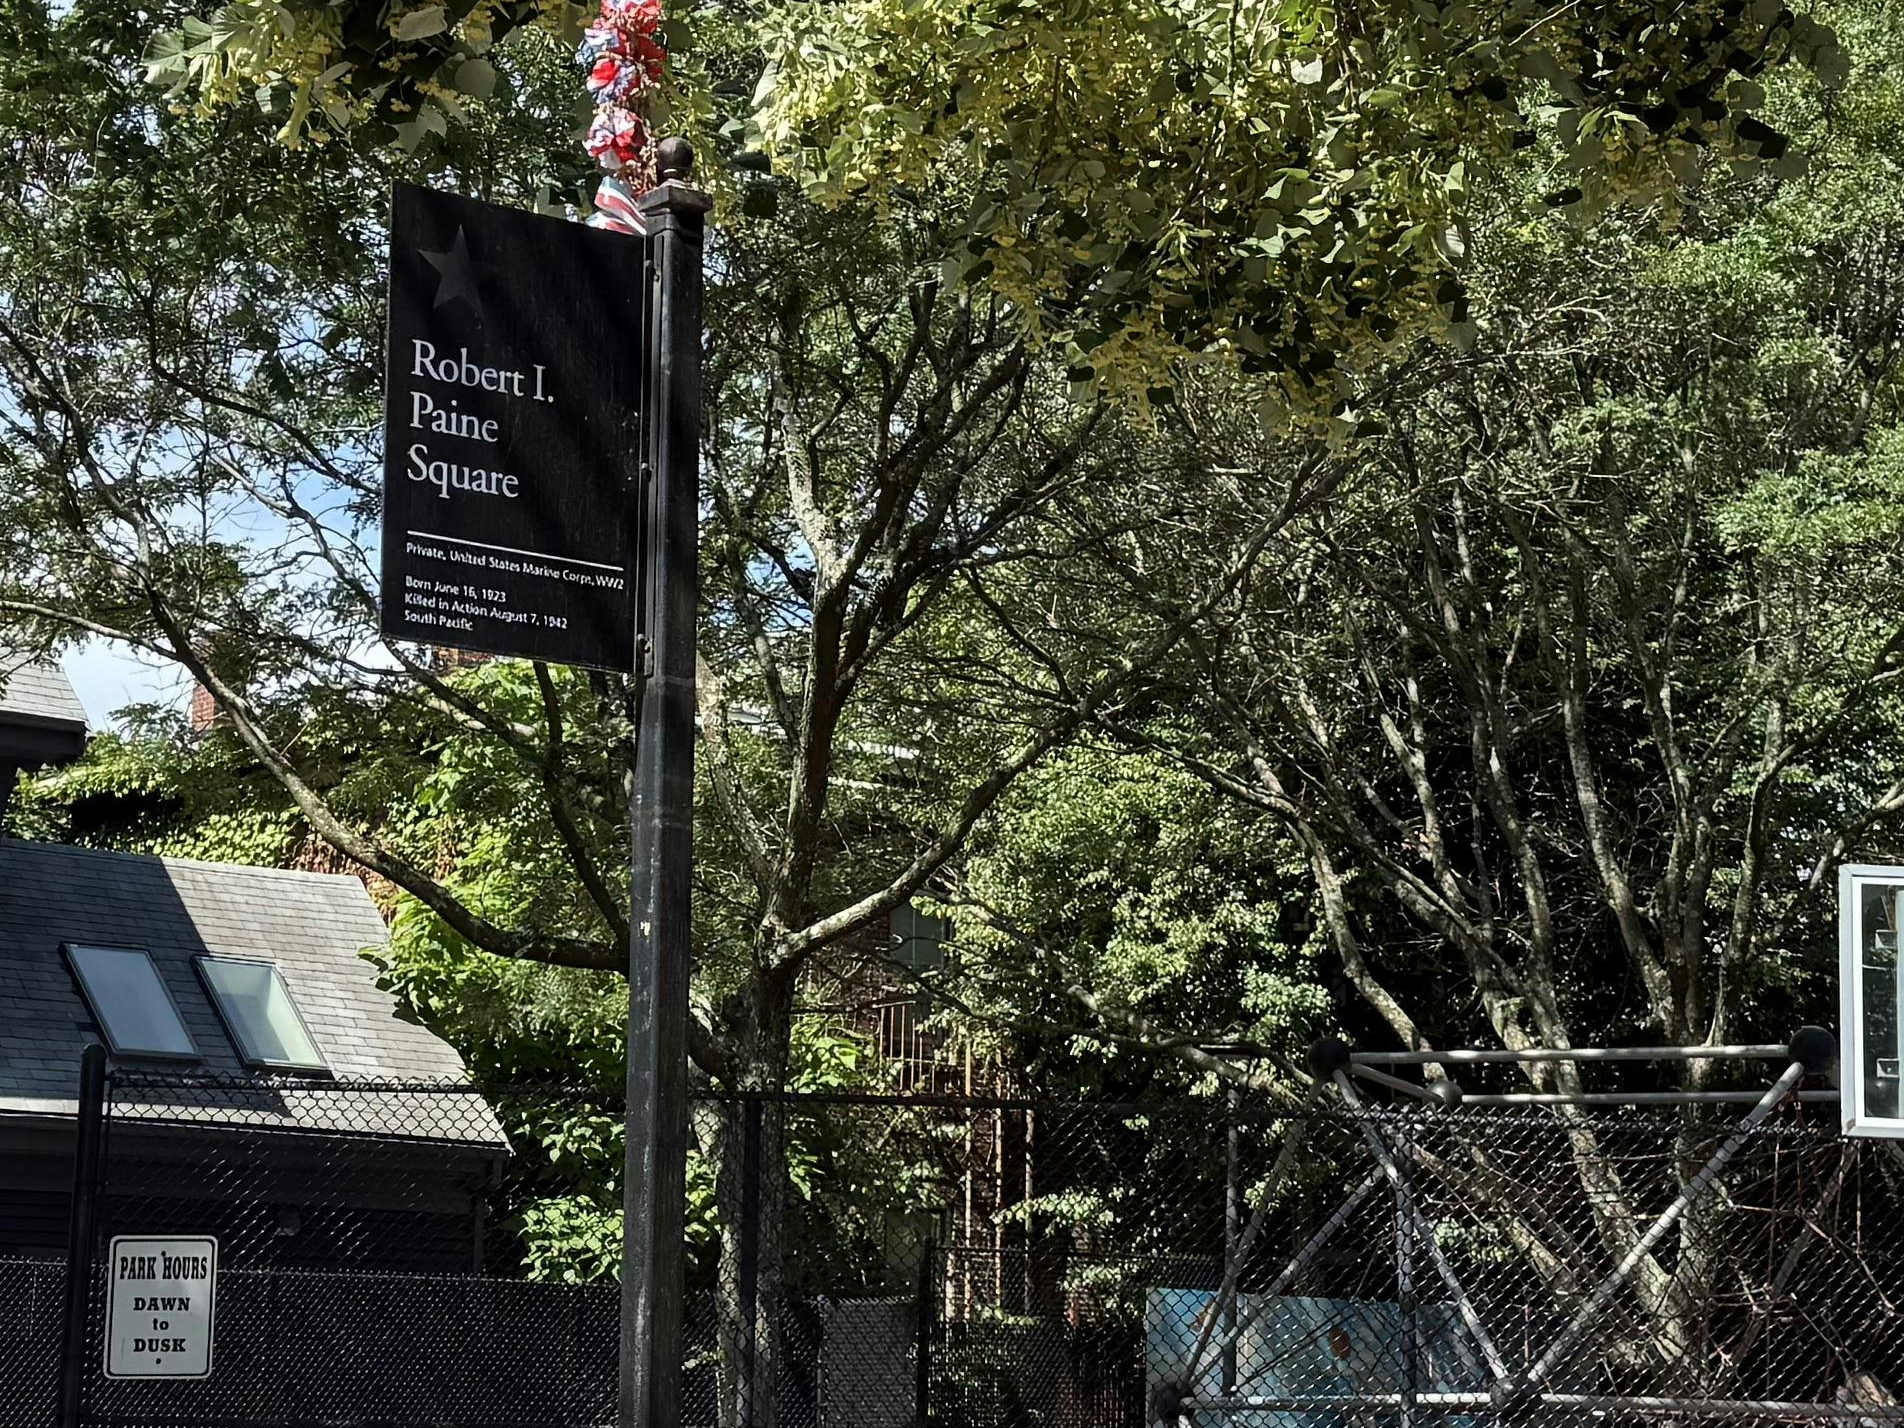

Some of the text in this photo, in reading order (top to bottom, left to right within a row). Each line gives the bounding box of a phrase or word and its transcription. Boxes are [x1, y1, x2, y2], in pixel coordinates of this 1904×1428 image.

[411, 338, 554, 403] Robert I.
[409, 391, 499, 443] Paine
[407, 443, 519, 499] Square
[406, 542, 446, 561] Private,
[450, 550, 486, 566] United
[489, 556, 520, 572] States
[523, 562, 560, 579] Marine
[405, 575, 432, 590] Born
[434, 581, 459, 595] June
[482, 588, 506, 603] 1923
[405, 592, 436, 608] Killed
[438, 597, 449, 610] in
[452, 600, 487, 617] Action
[489, 606, 527, 623] August
[544, 615, 568, 629] 1942
[405, 609, 474, 631] South Pacific
[120, 1256, 207, 1279] PARK HOURS
[133, 1297, 190, 1311] DAWN
[152, 1318, 169, 1330] to
[133, 1338, 186, 1352] DUSK
